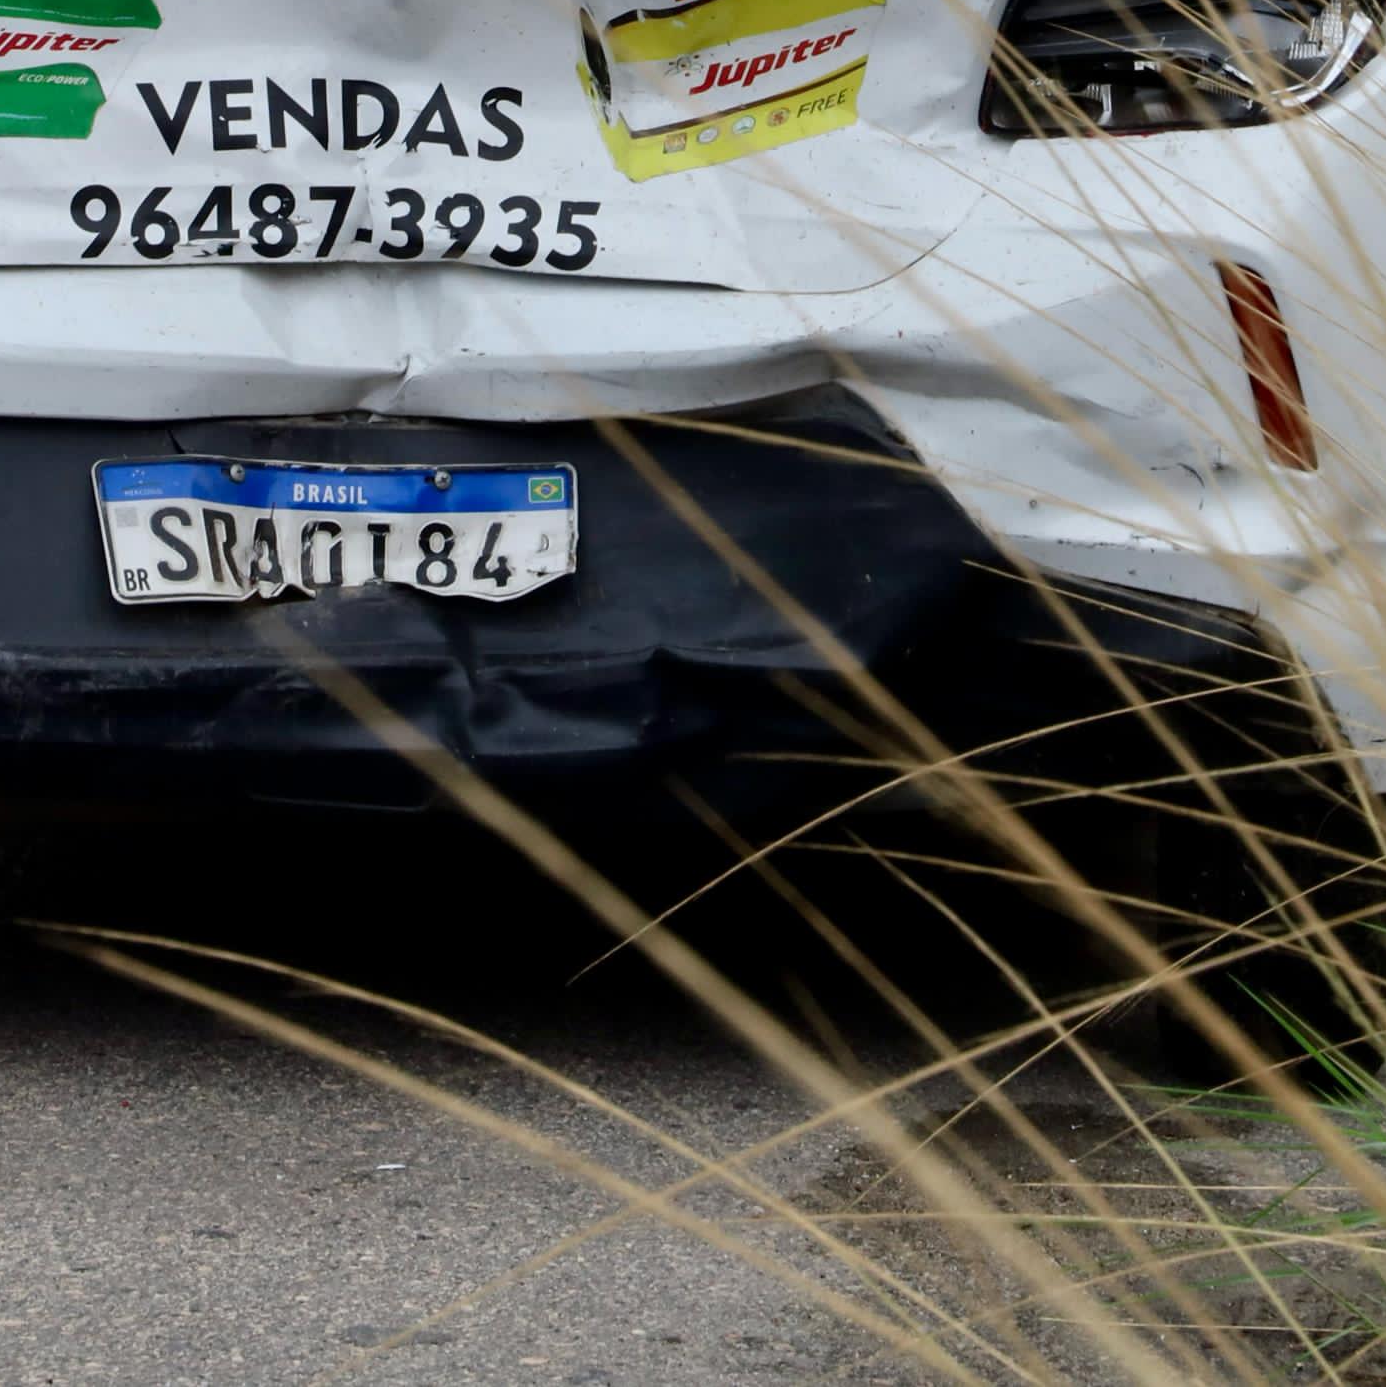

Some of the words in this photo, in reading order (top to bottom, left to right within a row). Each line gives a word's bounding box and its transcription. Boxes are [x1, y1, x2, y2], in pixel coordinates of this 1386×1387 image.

[796, 88, 850, 119] FREE
[136, 77, 524, 162] VENDAS
[69, 183, 602, 273] 96487-3935
[292, 482, 368, 505] BRASIL
[123, 567, 151, 592] BR
